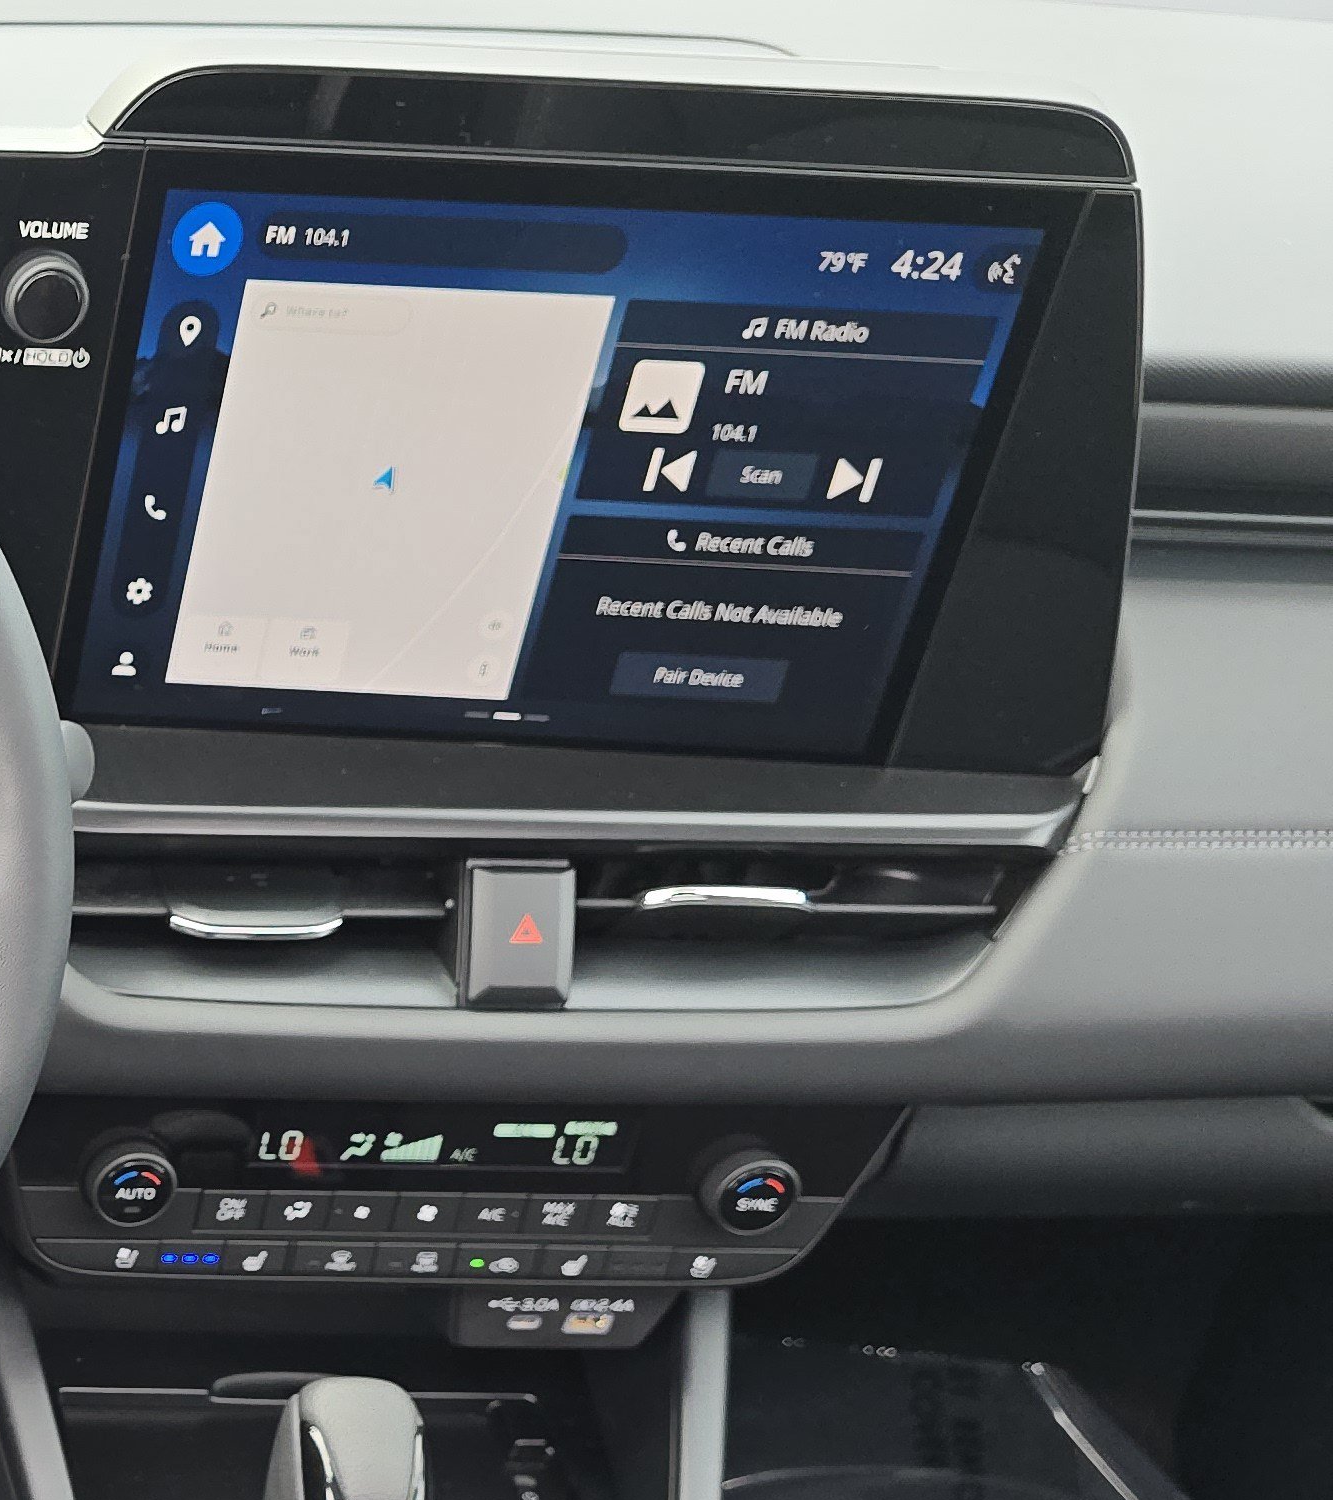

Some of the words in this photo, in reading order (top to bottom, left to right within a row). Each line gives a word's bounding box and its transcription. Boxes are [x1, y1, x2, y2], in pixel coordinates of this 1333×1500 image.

[19, 220, 89, 240] VOLUME
[265, 226, 296, 246] FM
[304, 228, 350, 248] 104.1
[819, 251, 868, 273] 79°F
[891, 250, 964, 281] 4:24
[774, 318, 807, 340] FM
[810, 320, 869, 344] Radio
[25, 350, 71, 365] HOLD
[725, 369, 768, 396] FM
[711, 425, 757, 443] 104.1
[740, 466, 782, 485] Scan
[694, 532, 764, 555] Recent
[766, 536, 814, 558] Calls
[595, 596, 664, 619] Recent
[666, 600, 712, 621] Calls
[714, 604, 752, 623] Not
[753, 604, 843, 628] Available
[653, 668, 687, 686] Pair
[688, 669, 744, 689] Device
[115, 1187, 156, 1200] AUTO
